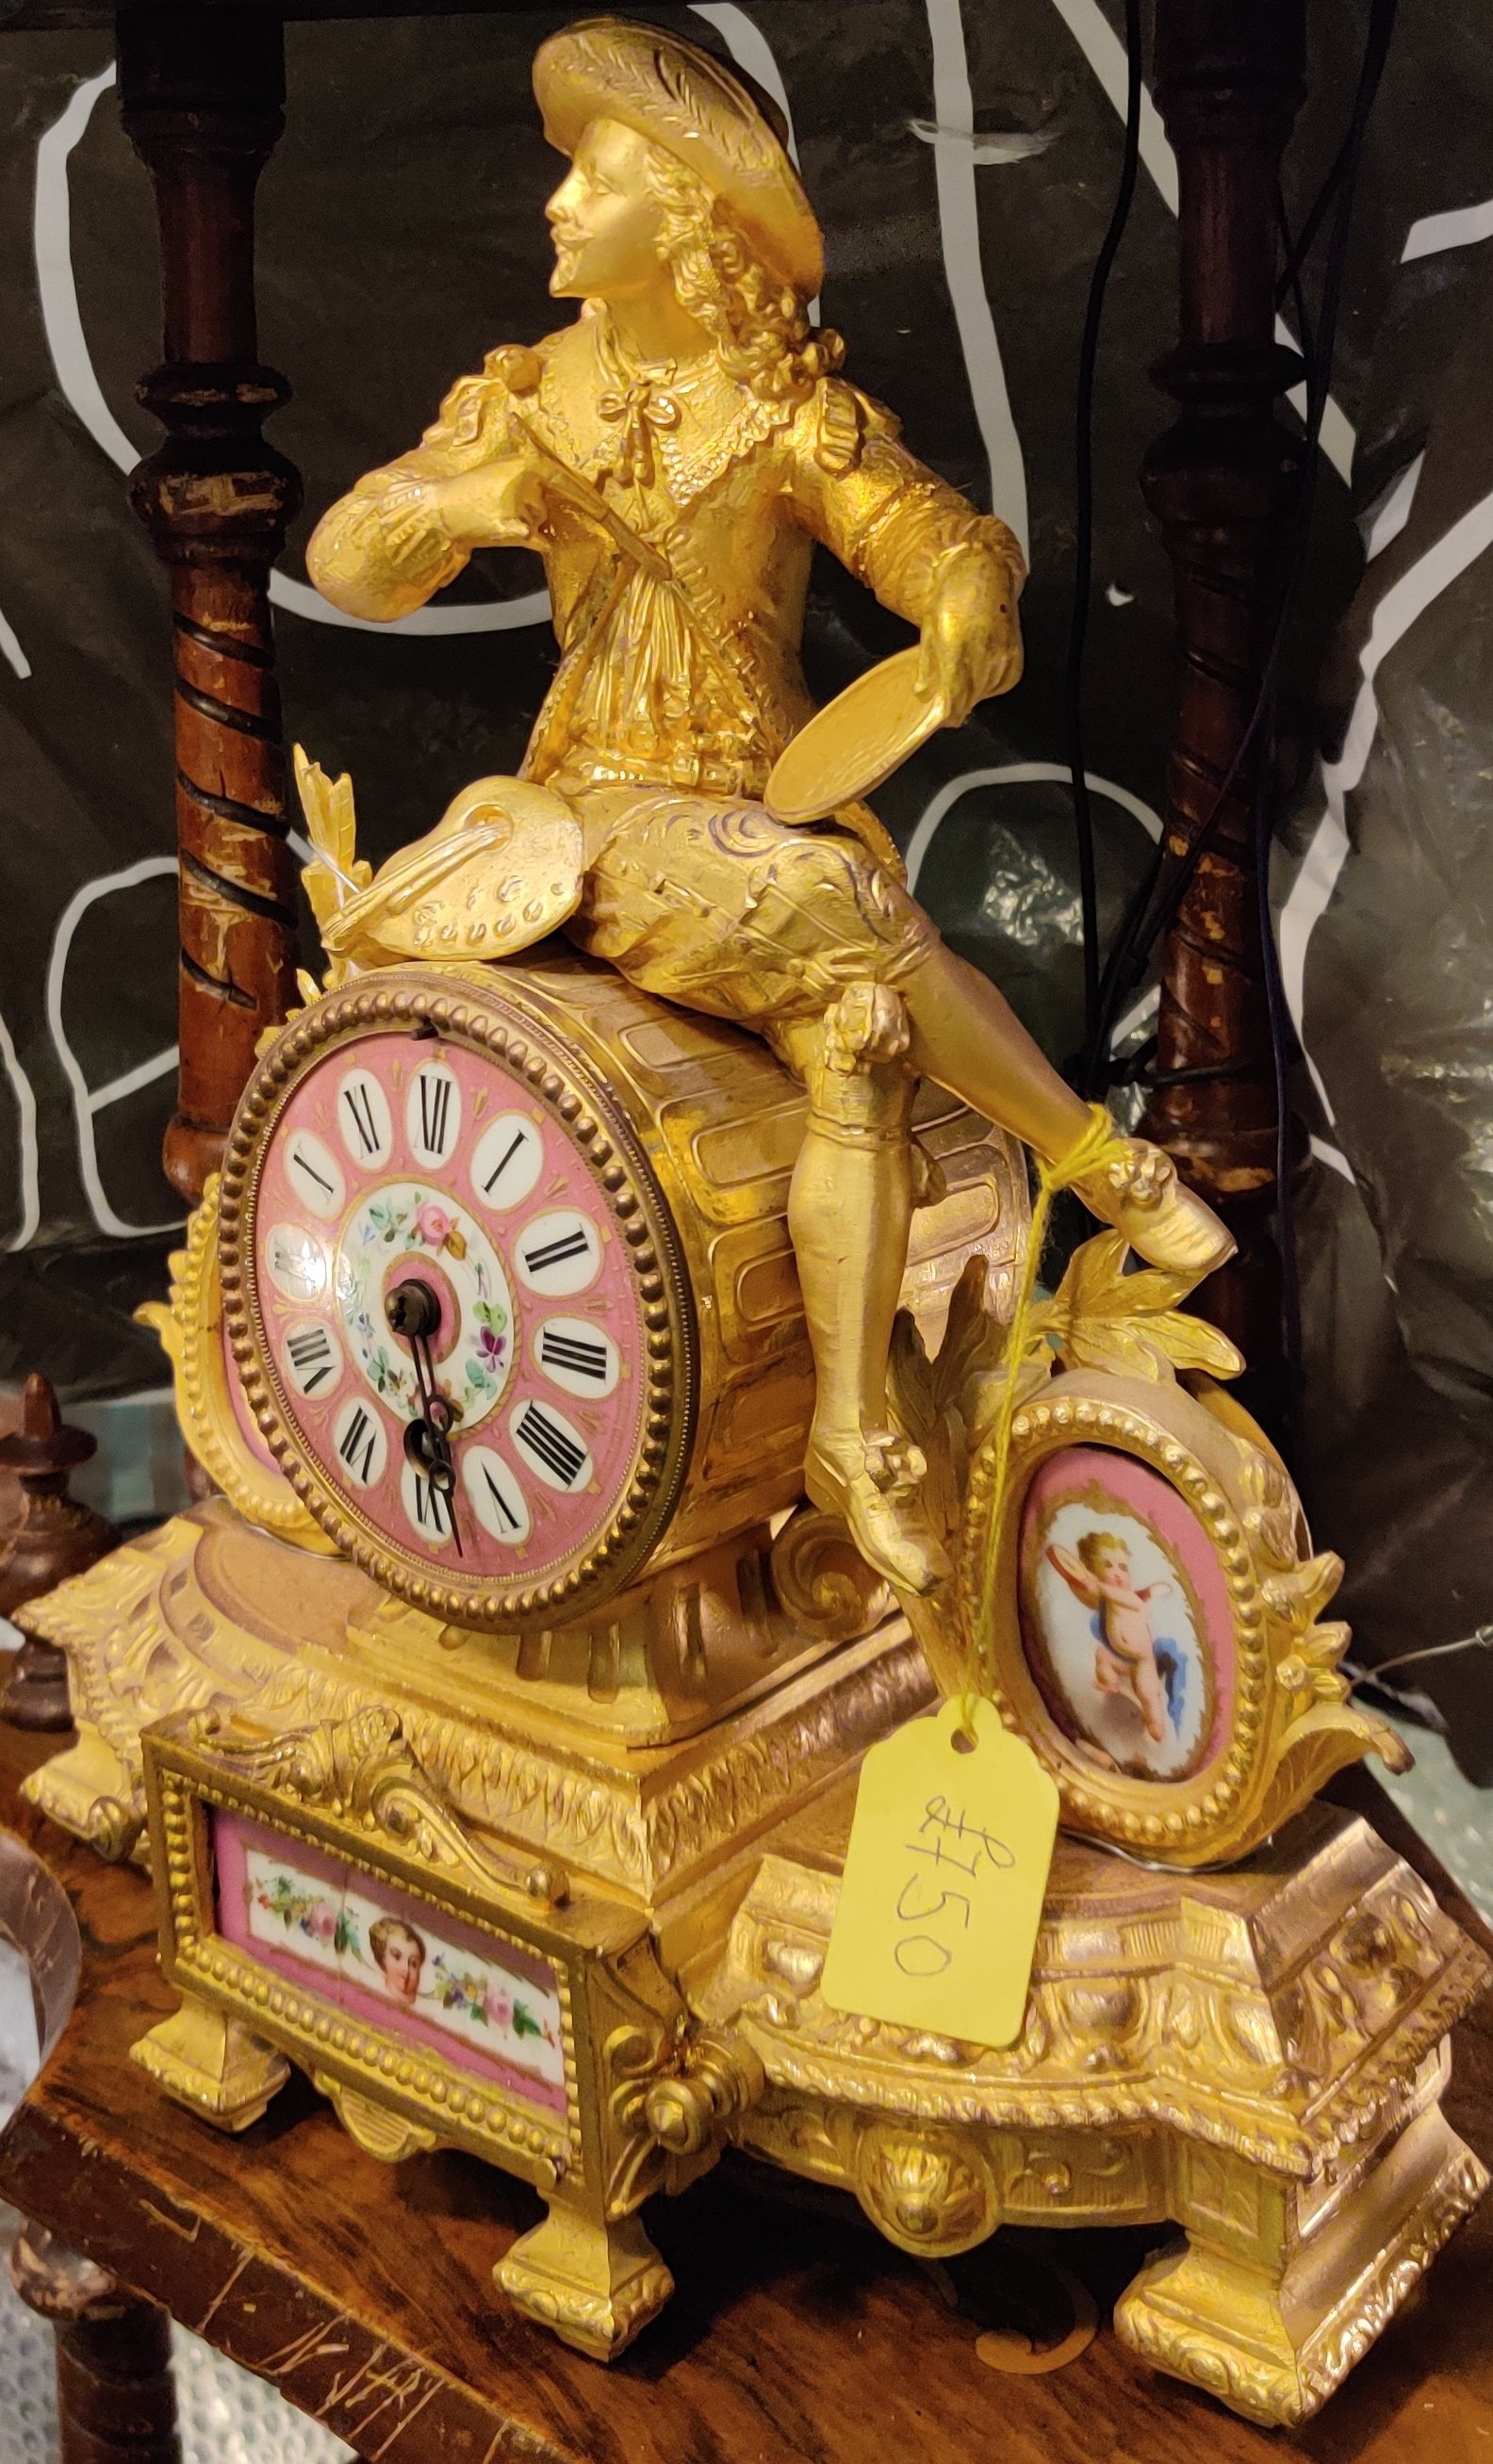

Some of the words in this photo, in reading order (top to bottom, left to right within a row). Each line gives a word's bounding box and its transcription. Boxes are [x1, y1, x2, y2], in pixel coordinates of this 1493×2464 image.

[343, 1084, 381, 1159] XI
[413, 1074, 452, 1157] XII
[482, 1130, 528, 1195] I
[523, 1224, 592, 1278] II
[287, 1328, 336, 1395] VIII
[542, 1327, 607, 1385] III
[339, 1406, 377, 1485] VII
[517, 1399, 589, 1490] IIII
[481, 1460, 522, 1534] V
[894, 1795, 1016, 1977] £750
